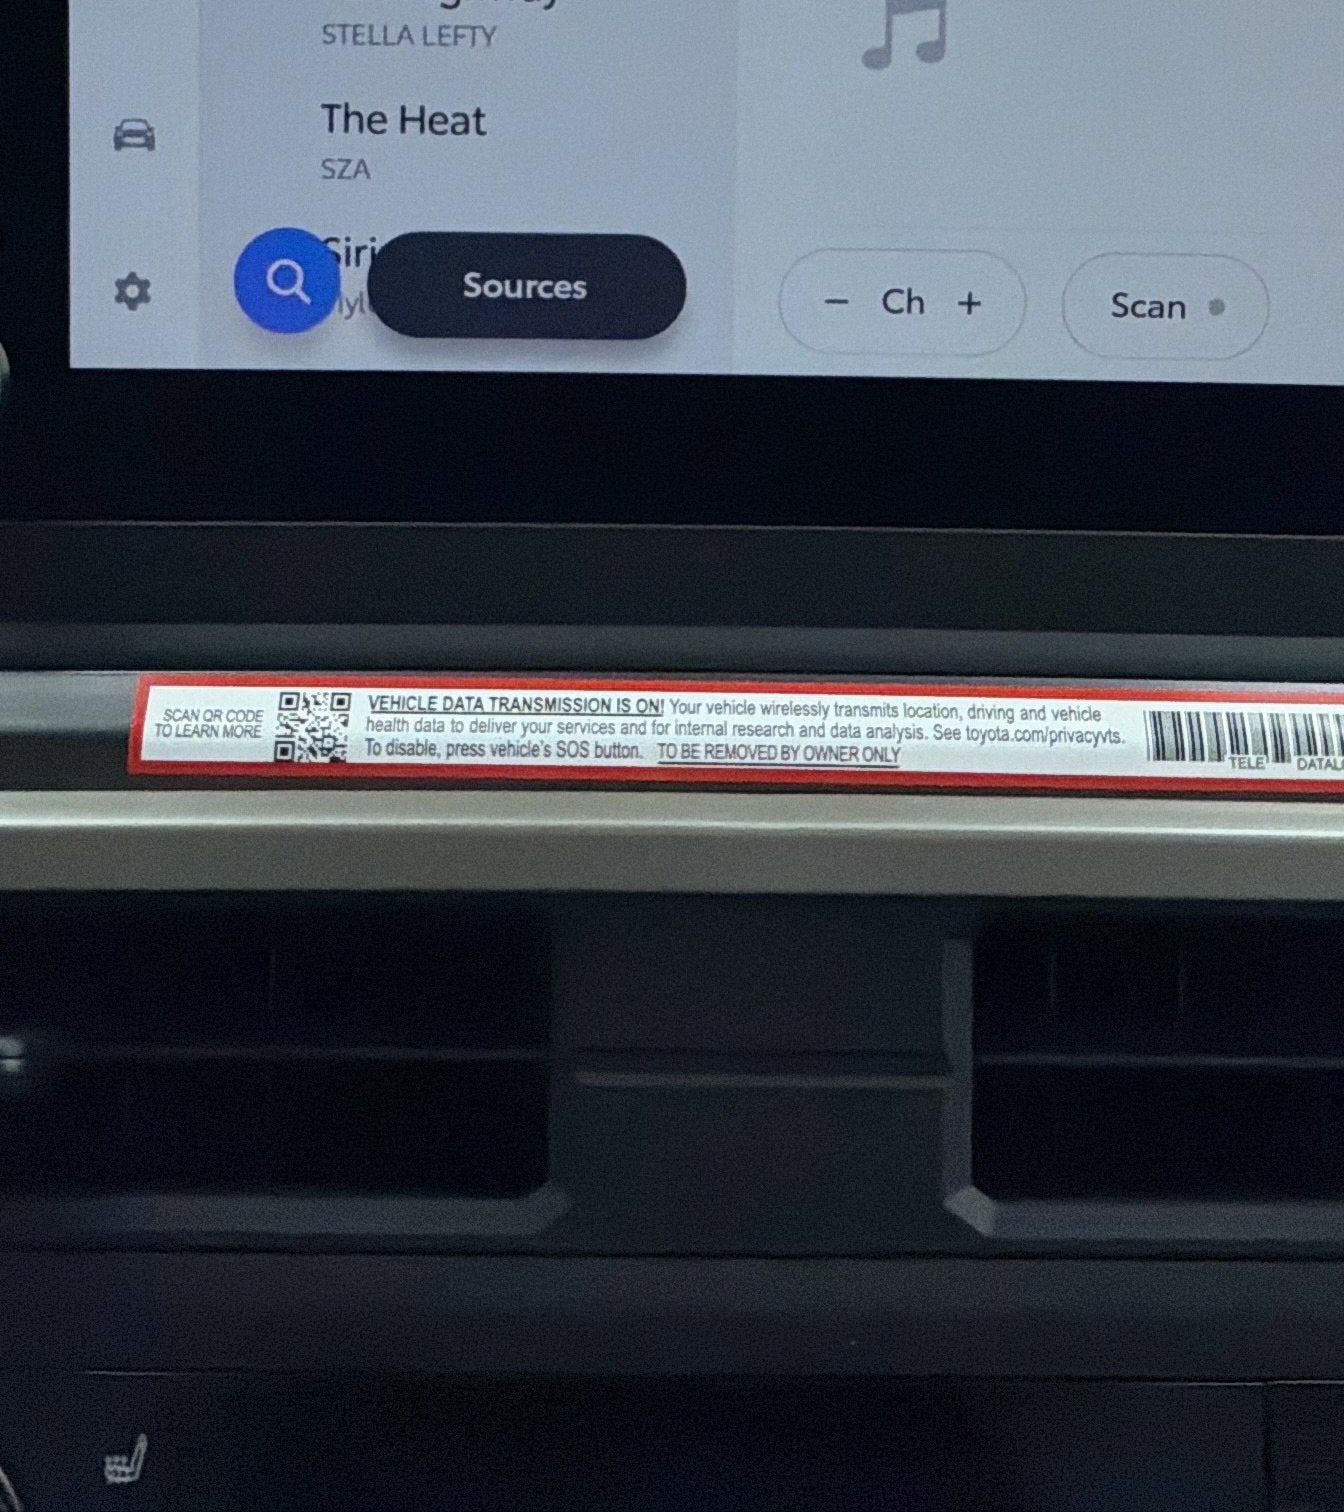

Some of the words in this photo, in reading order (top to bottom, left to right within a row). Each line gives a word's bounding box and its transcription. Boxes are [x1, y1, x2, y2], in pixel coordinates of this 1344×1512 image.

[322, 23, 414, 46] STELLA
[423, 25, 497, 47] LEFTY
[321, 103, 388, 135] The
[399, 104, 487, 136] Heat
[321, 158, 371, 180] SZA
[463, 272, 587, 301] Sources
[882, 288, 925, 315] Ch
[1111, 292, 1187, 321] Scan
[163, 709, 199, 722] SCAN
[203, 710, 223, 722] QR
[226, 710, 264, 722] CODE
[369, 695, 438, 711] VEHICLE
[443, 696, 484, 711] DATA
[490, 697, 611, 713] TRANSMISSION
[617, 698, 631, 713] IS
[636, 699, 664, 713] ON!
[670, 699, 701, 715] Your
[707, 700, 755, 715] vehicle
[761, 701, 829, 720] wirelessly
[834, 702, 899, 718] transmits
[904, 703, 963, 721] location,
[968, 705, 1014, 724] driving
[1020, 706, 1046, 721] and
[1051, 706, 1101, 722] vehicle
[155, 723, 172, 737] TO
[175, 724, 219, 738] LEARN
[223, 725, 262, 738] MORE
[366, 716, 409, 732] health
[414, 717, 445, 733] data
[450, 719, 464, 733] to
[469, 718, 517, 733] deliver
[521, 722, 552, 737] your
[558, 721, 615, 735] services
[621, 720, 647, 735] and
[652, 720, 670, 735] for
[675, 721, 727, 736] internal
[733, 722, 794, 737] research
[800, 723, 825, 738] and
[831, 723, 860, 738] data
[866, 724, 928, 743] analysis.
[933, 725, 961, 740] See
[966, 726, 1125, 747] toyota.com/privacyvts.
[365, 738, 381, 756] To
[386, 739, 441, 759] disable,
[446, 742, 485, 759] press
[490, 740, 552, 757] vehicle's
[557, 740, 590, 758] SOS
[595, 741, 643, 759] button.
[657, 743, 678, 759] TO
[681, 744, 701, 759] BE
[705, 744, 777, 760] REMOVED
[781, 745, 800, 760] BY
[804, 746, 859, 762] OWNER
[863, 746, 901, 762] ONLY
[1228, 756, 1266, 770] TELE
